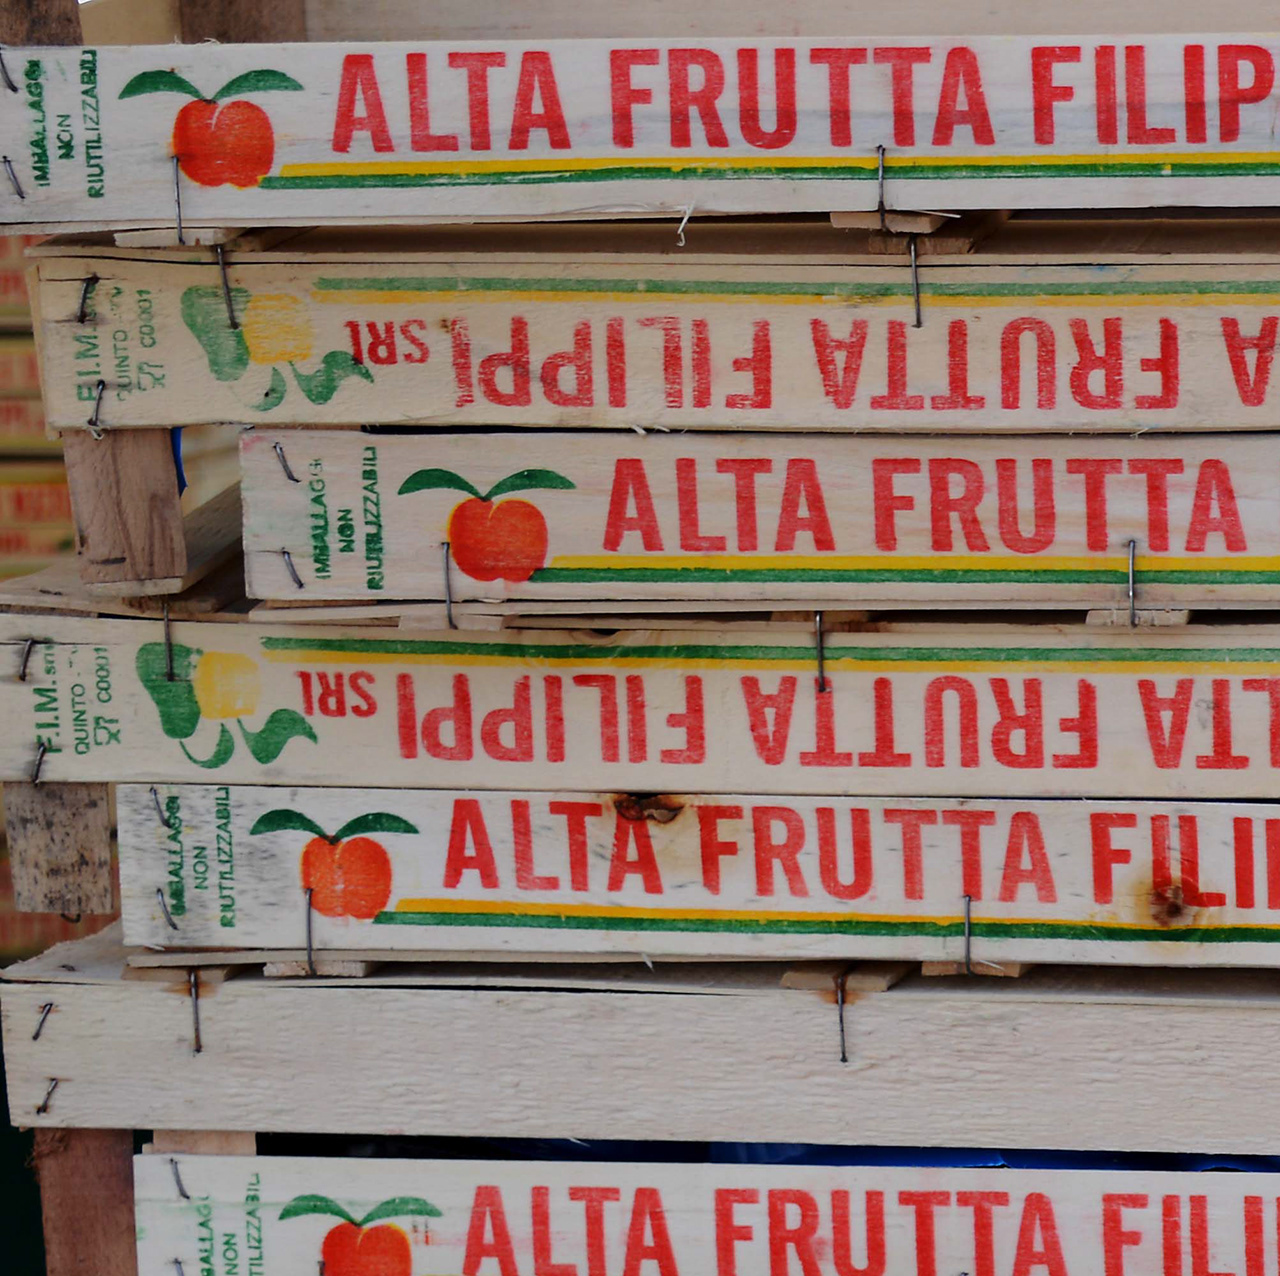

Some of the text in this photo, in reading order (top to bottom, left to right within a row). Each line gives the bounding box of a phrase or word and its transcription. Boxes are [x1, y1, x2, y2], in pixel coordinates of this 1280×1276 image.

[57, 114, 74, 160] NON
[332, 51, 571, 153] ALTA
[610, 46, 995, 149] FRUTTA
[344, 319, 429, 366] SRL
[451, 316, 773, 409] FILIPPI
[810, 317, 1180, 411] FRUTTA
[337, 508, 355, 554] NON
[603, 457, 836, 552] ALTA
[872, 457, 1247, 554] FRUTTA
[70, 682, 90, 756] QUINTO
[297, 671, 378, 718] SRL
[396, 673, 706, 764] FILIPPI
[740, 675, 1099, 769] FRUTTA
[193, 846, 209, 892] NON
[446, 799, 663, 893] ALTA
[696, 806, 1057, 902] FRUTTA
[223, 1233, 240, 1276] NON
